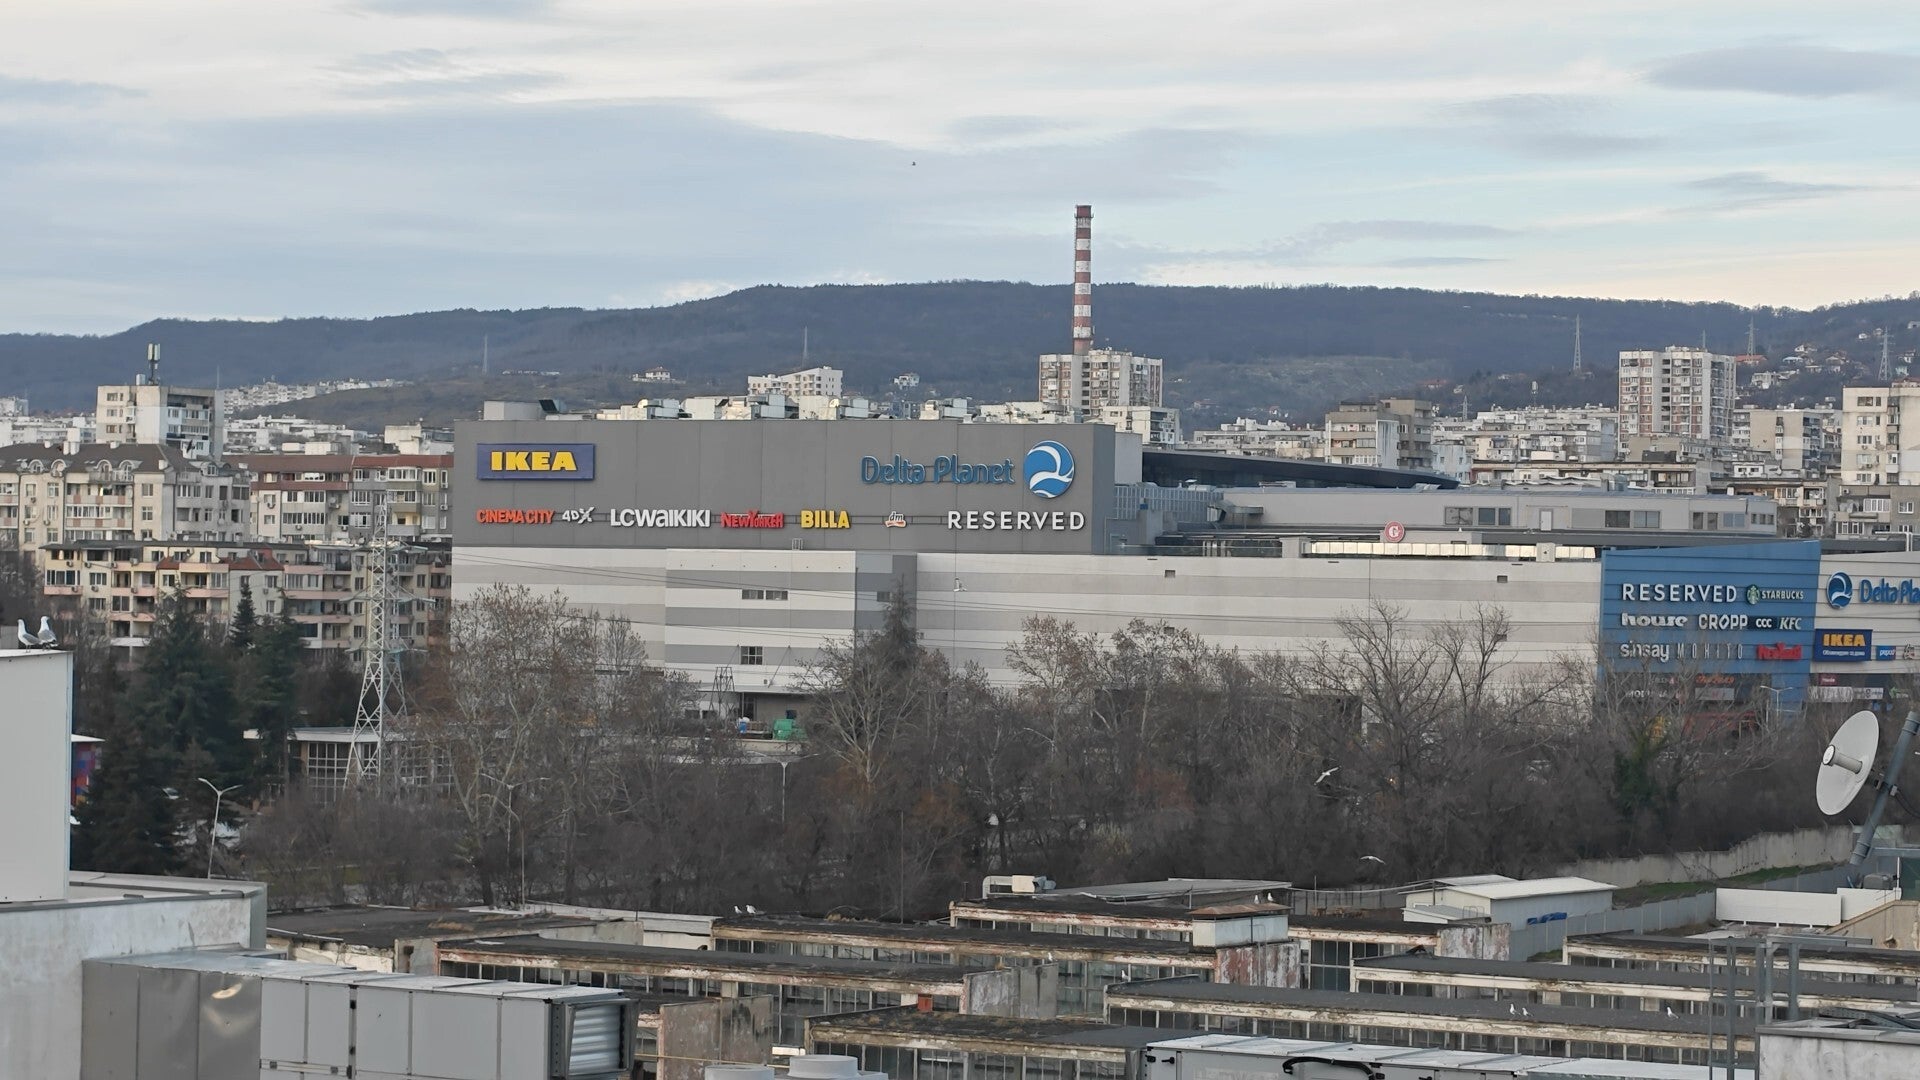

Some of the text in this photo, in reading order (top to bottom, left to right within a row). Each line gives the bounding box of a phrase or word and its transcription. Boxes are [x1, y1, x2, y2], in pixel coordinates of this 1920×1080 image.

[490, 451, 578, 471] IKEA
[861, 454, 1016, 484] Delta Planet
[562, 507, 595, 524] 4DX
[801, 510, 850, 528] BILLA
[948, 511, 1085, 530] RESERVED
[1621, 583, 1738, 603] RESERVED
[1761, 590, 1805, 600] STARBUCKS
[1859, 578, 1898, 603] Delta
[1621, 612, 1688, 627] house
[1698, 613, 1748, 630] CROPP
[1779, 617, 1802, 630] KFC
[1823, 634, 1866, 647] IKEA
[1620, 640, 1670, 662] sinsay
[1677, 642, 1743, 659] MOHITO
